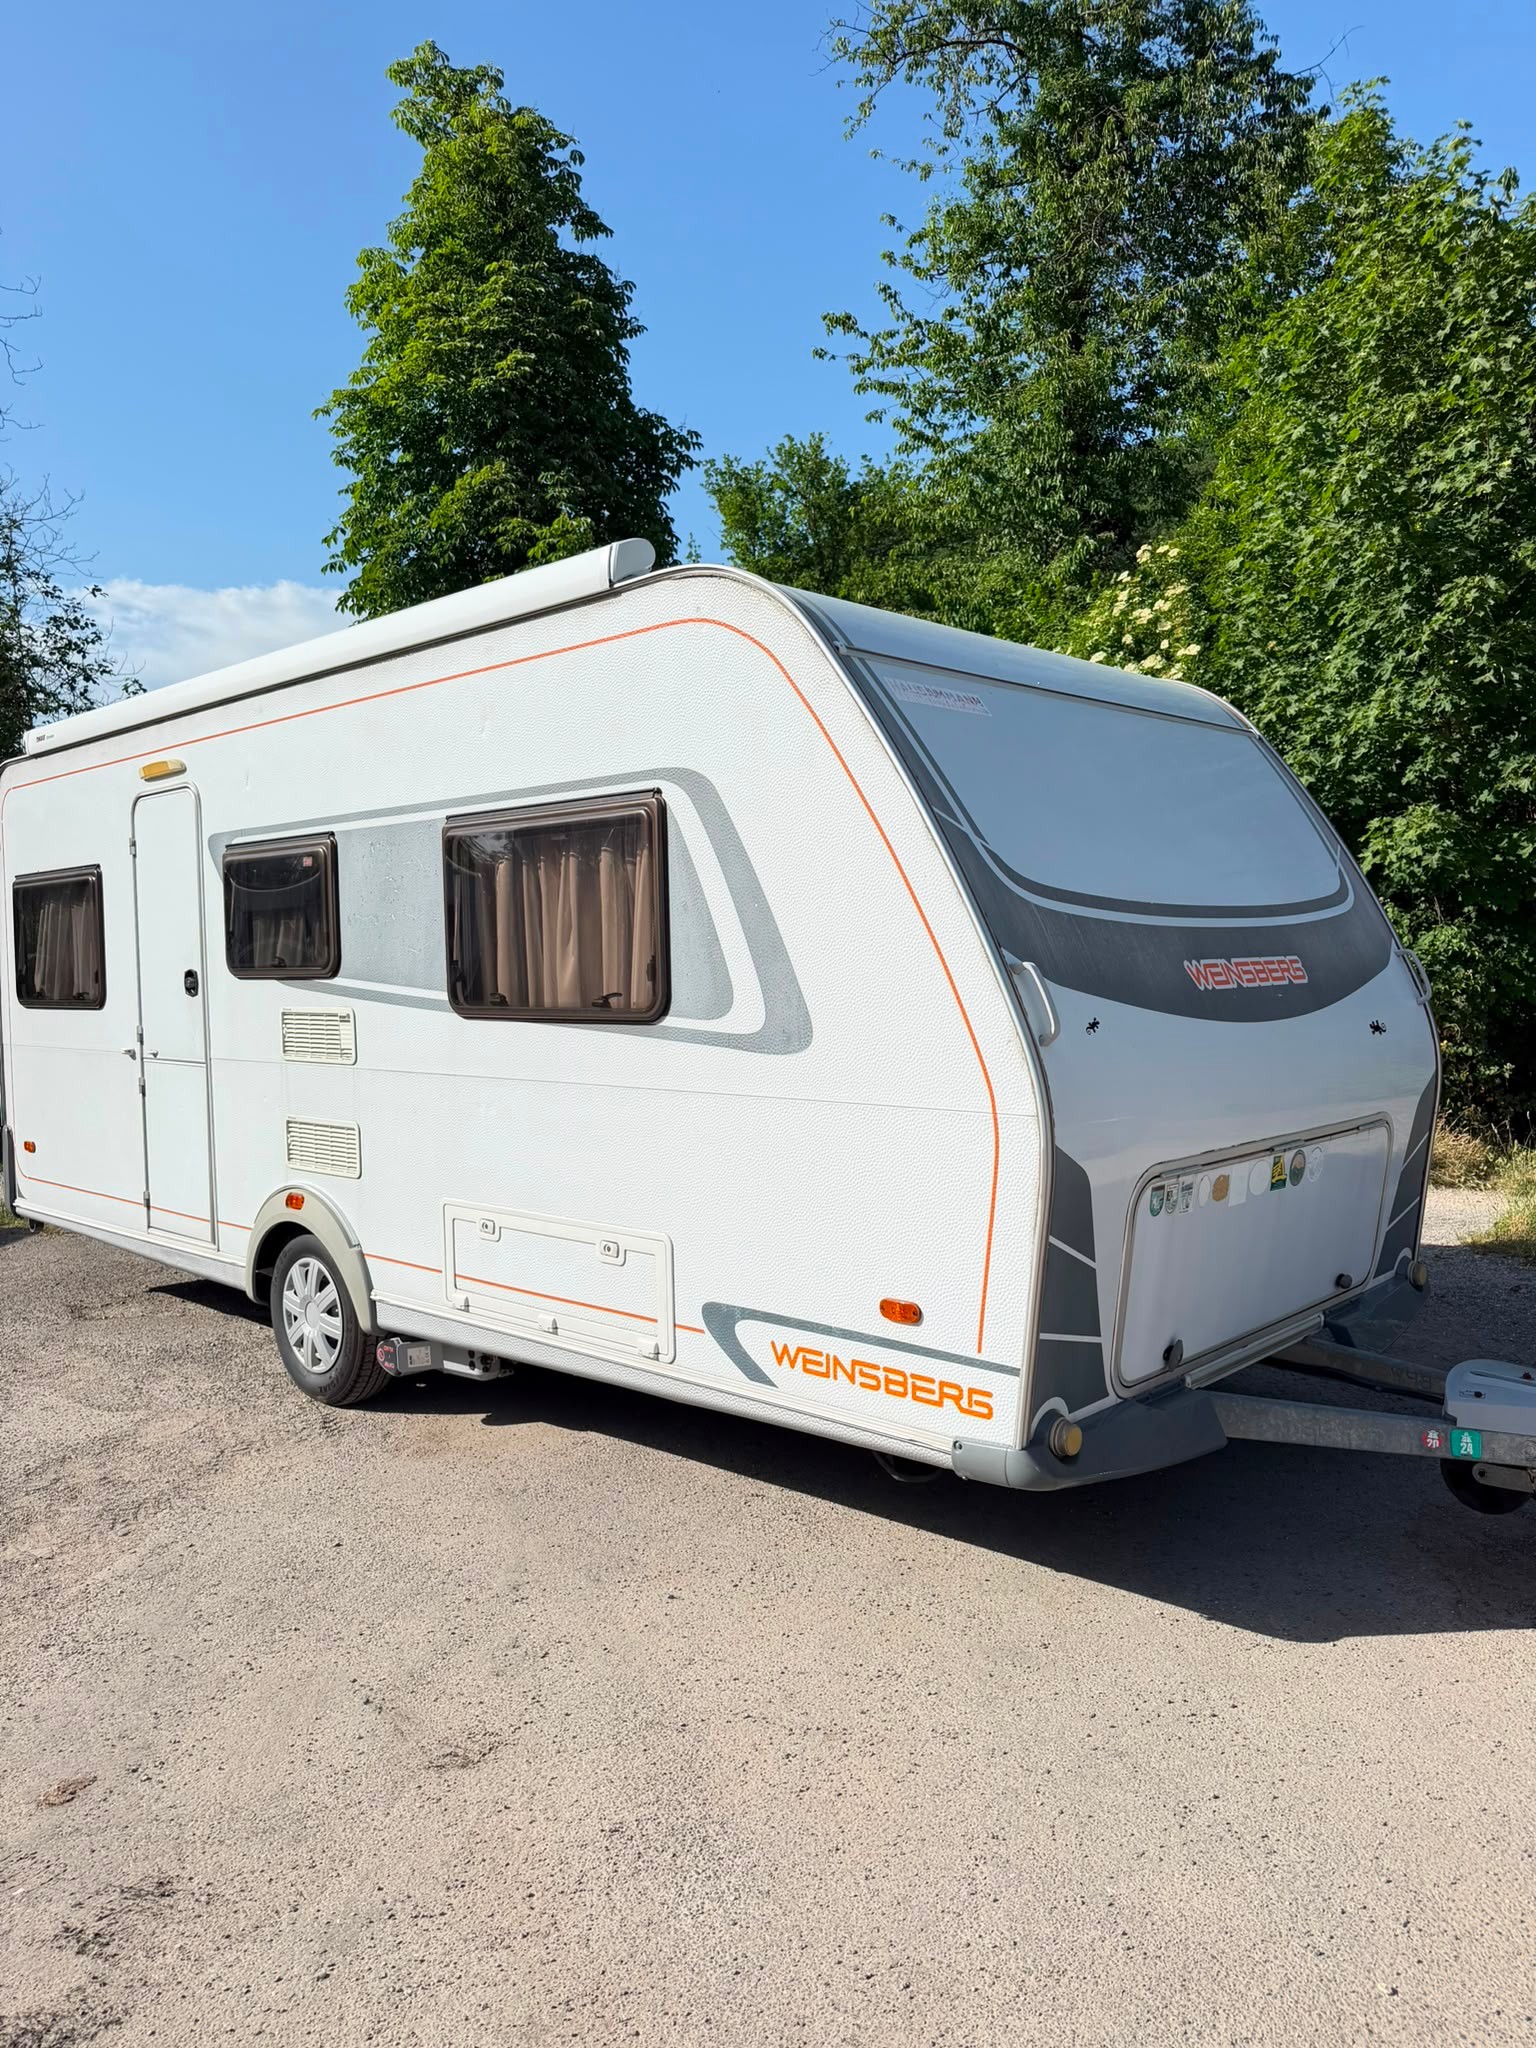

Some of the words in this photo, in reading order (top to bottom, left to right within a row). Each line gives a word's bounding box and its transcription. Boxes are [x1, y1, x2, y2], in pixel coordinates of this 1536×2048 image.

[1183, 955, 1308, 990] WEINSBERG
[770, 1340, 994, 1420] WEINSBERG
[1460, 1443, 1473, 1455] 24
